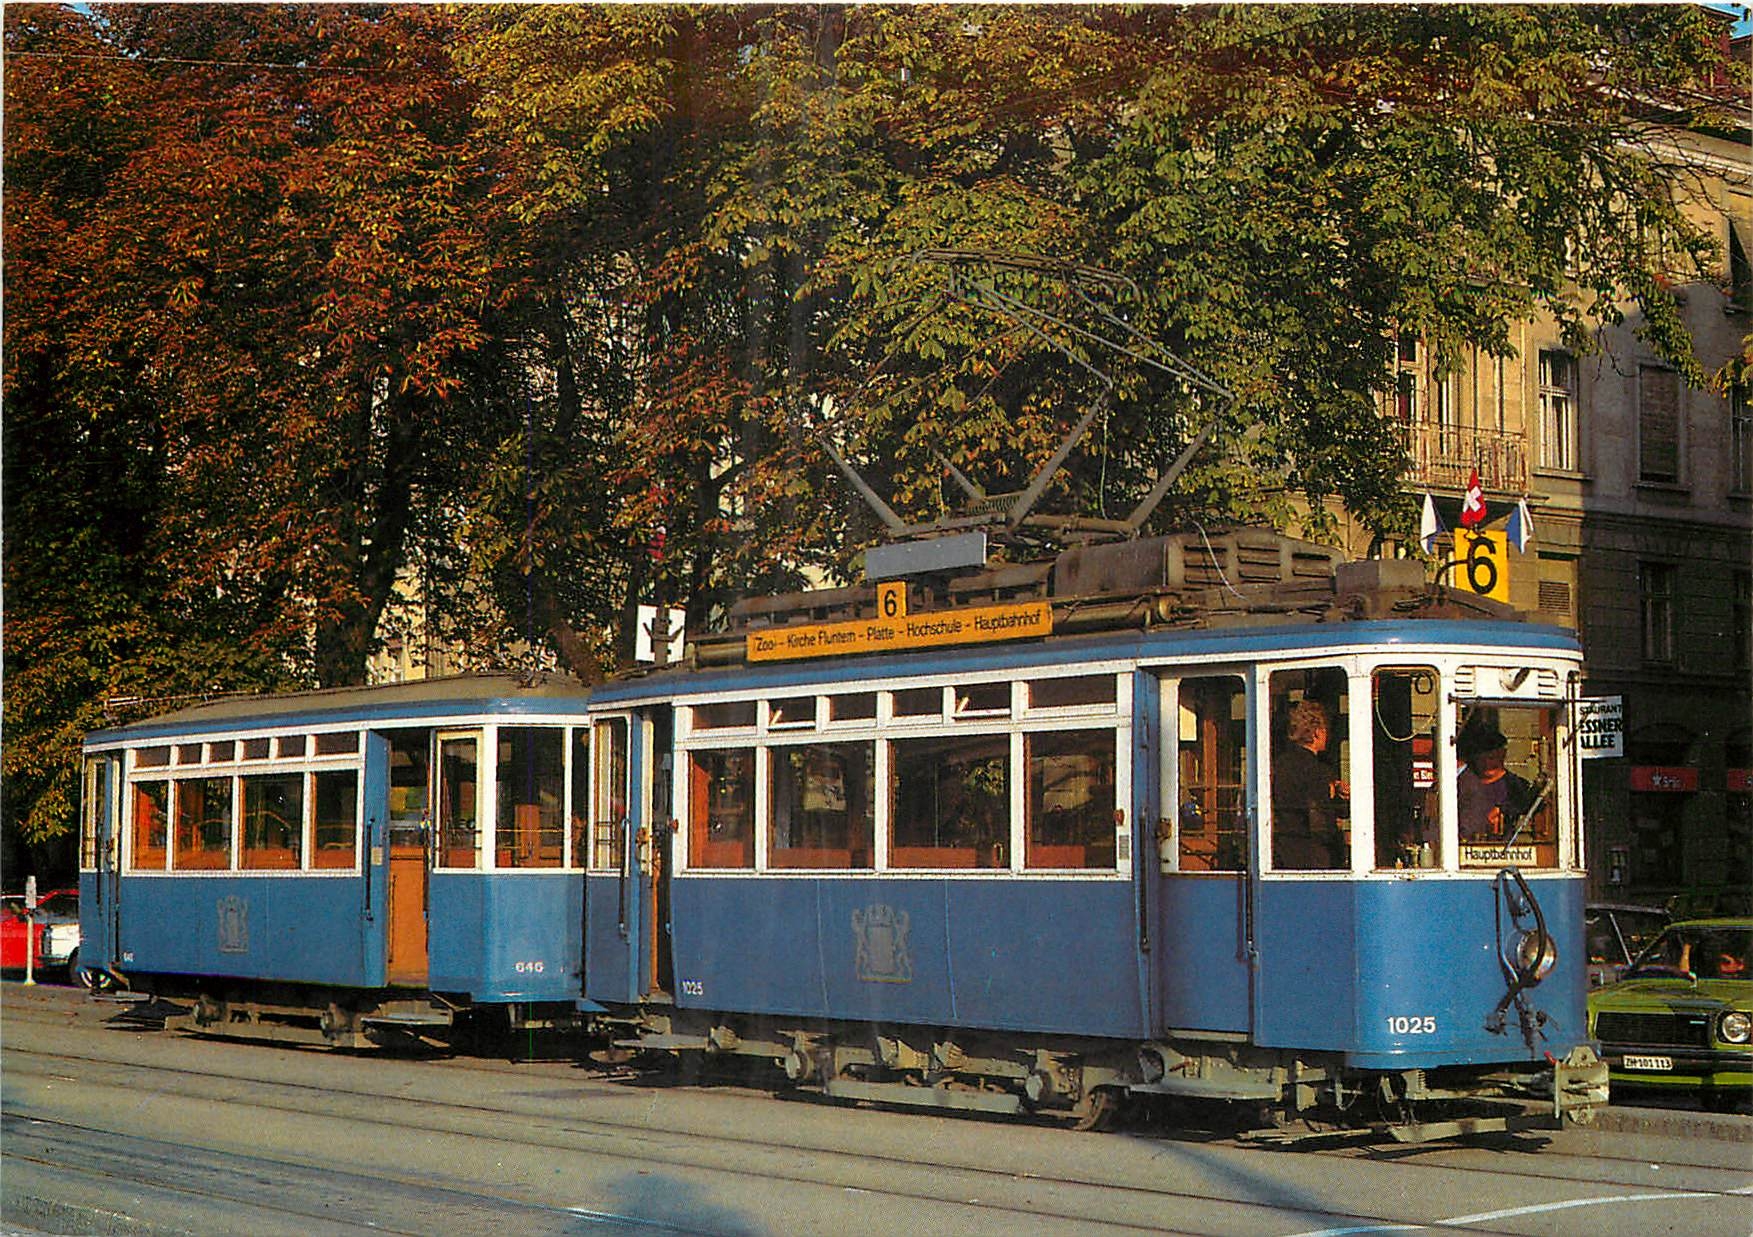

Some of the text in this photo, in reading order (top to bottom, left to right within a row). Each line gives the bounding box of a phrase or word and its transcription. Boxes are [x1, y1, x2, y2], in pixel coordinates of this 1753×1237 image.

[1467, 537, 1498, 594] 6
[885, 590, 897, 617] 6
[754, 636, 774, 652] Zoo
[787, 632, 816, 649] Kirche
[866, 625, 895, 641] Platte
[907, 618, 962, 637] Hochschule
[974, 608, 1041, 633] Hauptbahnhof
[1465, 846, 1532, 864] Hauptbahnhof
[515, 960, 545, 973] 646
[682, 980, 704, 996] 1025
[1387, 1016, 1437, 1034] 1025
